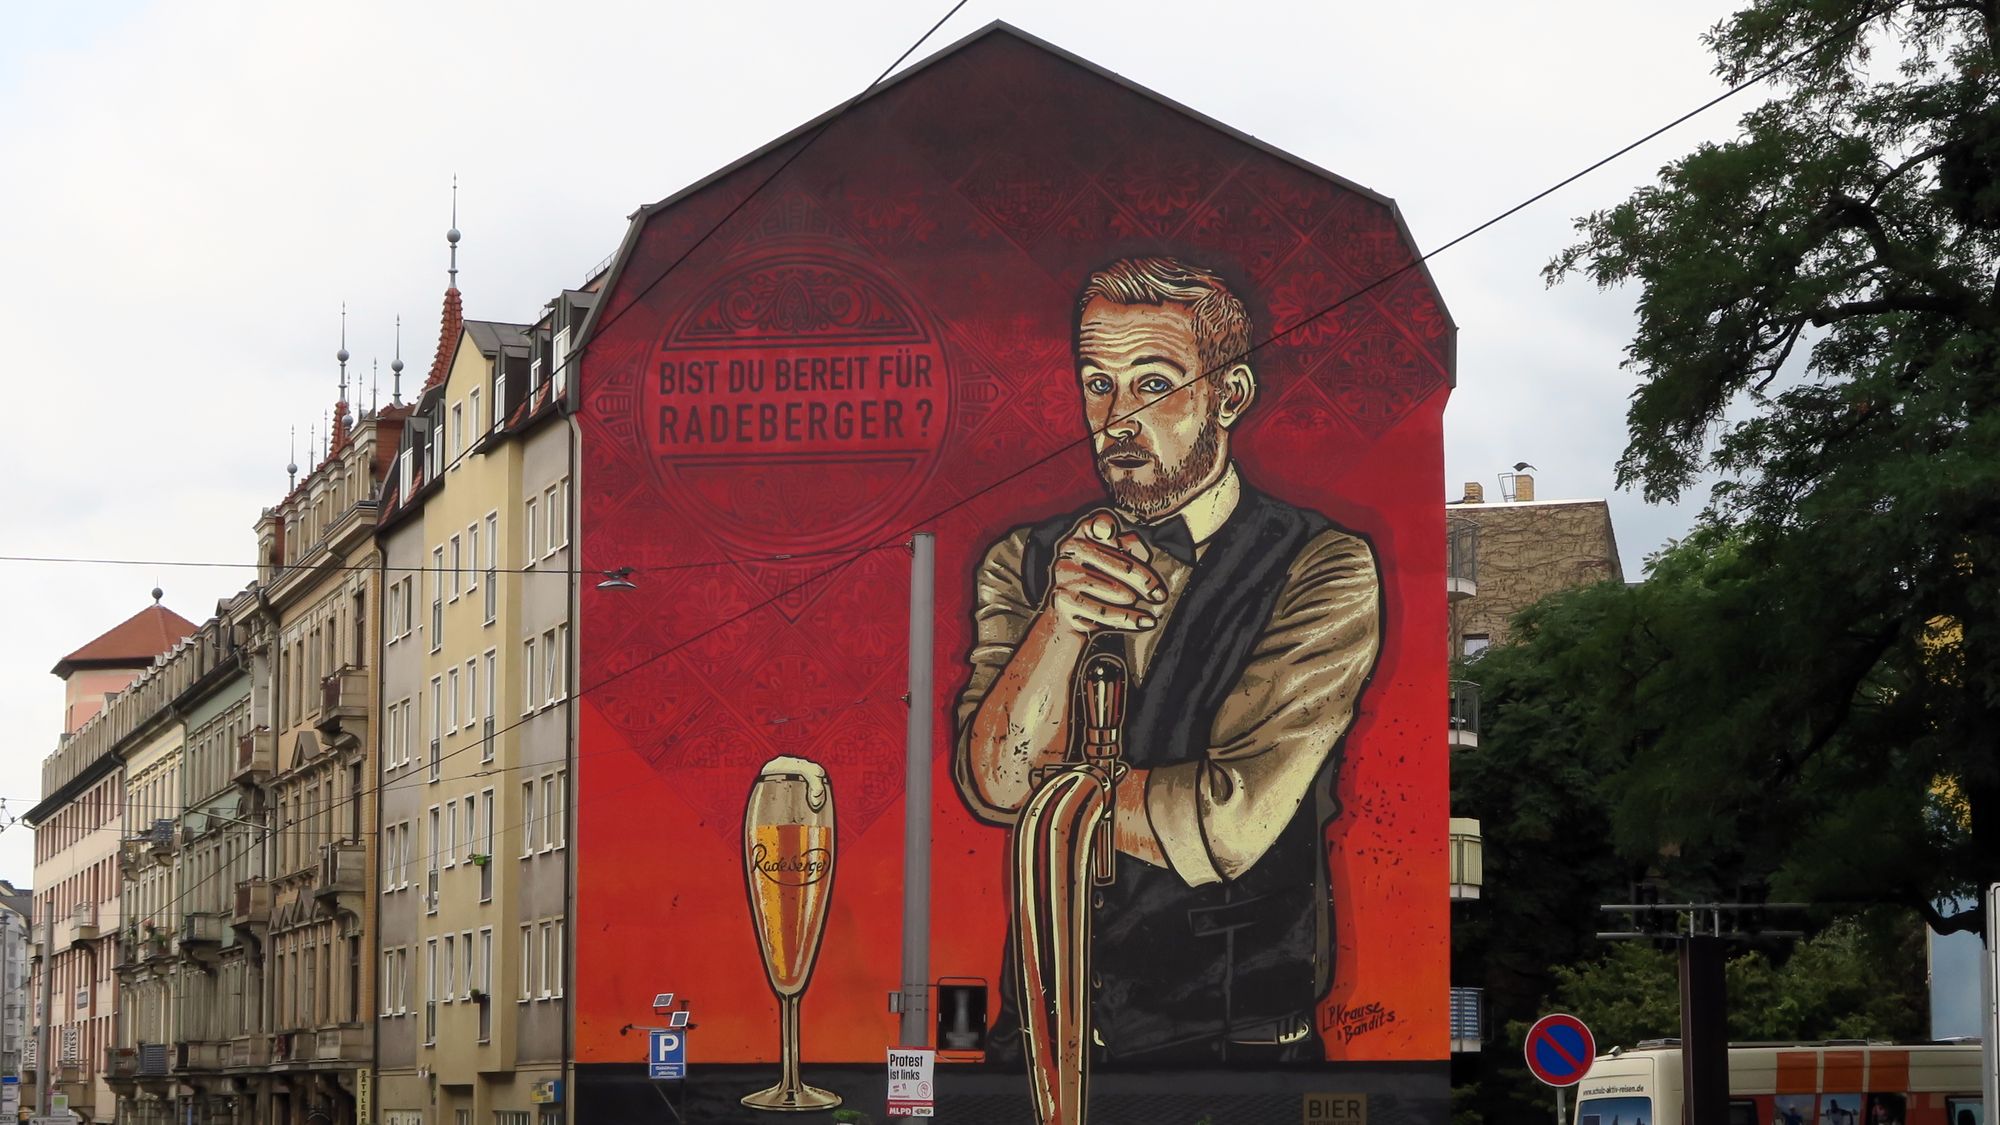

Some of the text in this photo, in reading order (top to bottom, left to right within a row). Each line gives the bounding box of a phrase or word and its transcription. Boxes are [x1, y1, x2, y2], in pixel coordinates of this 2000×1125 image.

[659, 348, 932, 395] BIST DU BEREIT FÜR
[659, 398, 933, 444] RADEBERGER ?
[660, 1034, 679, 1062] P
[889, 1053, 923, 1067] Protest
[889, 1069, 920, 1081] ist links
[889, 1107, 912, 1115] MLPD
[1308, 1100, 1361, 1119] BIER
